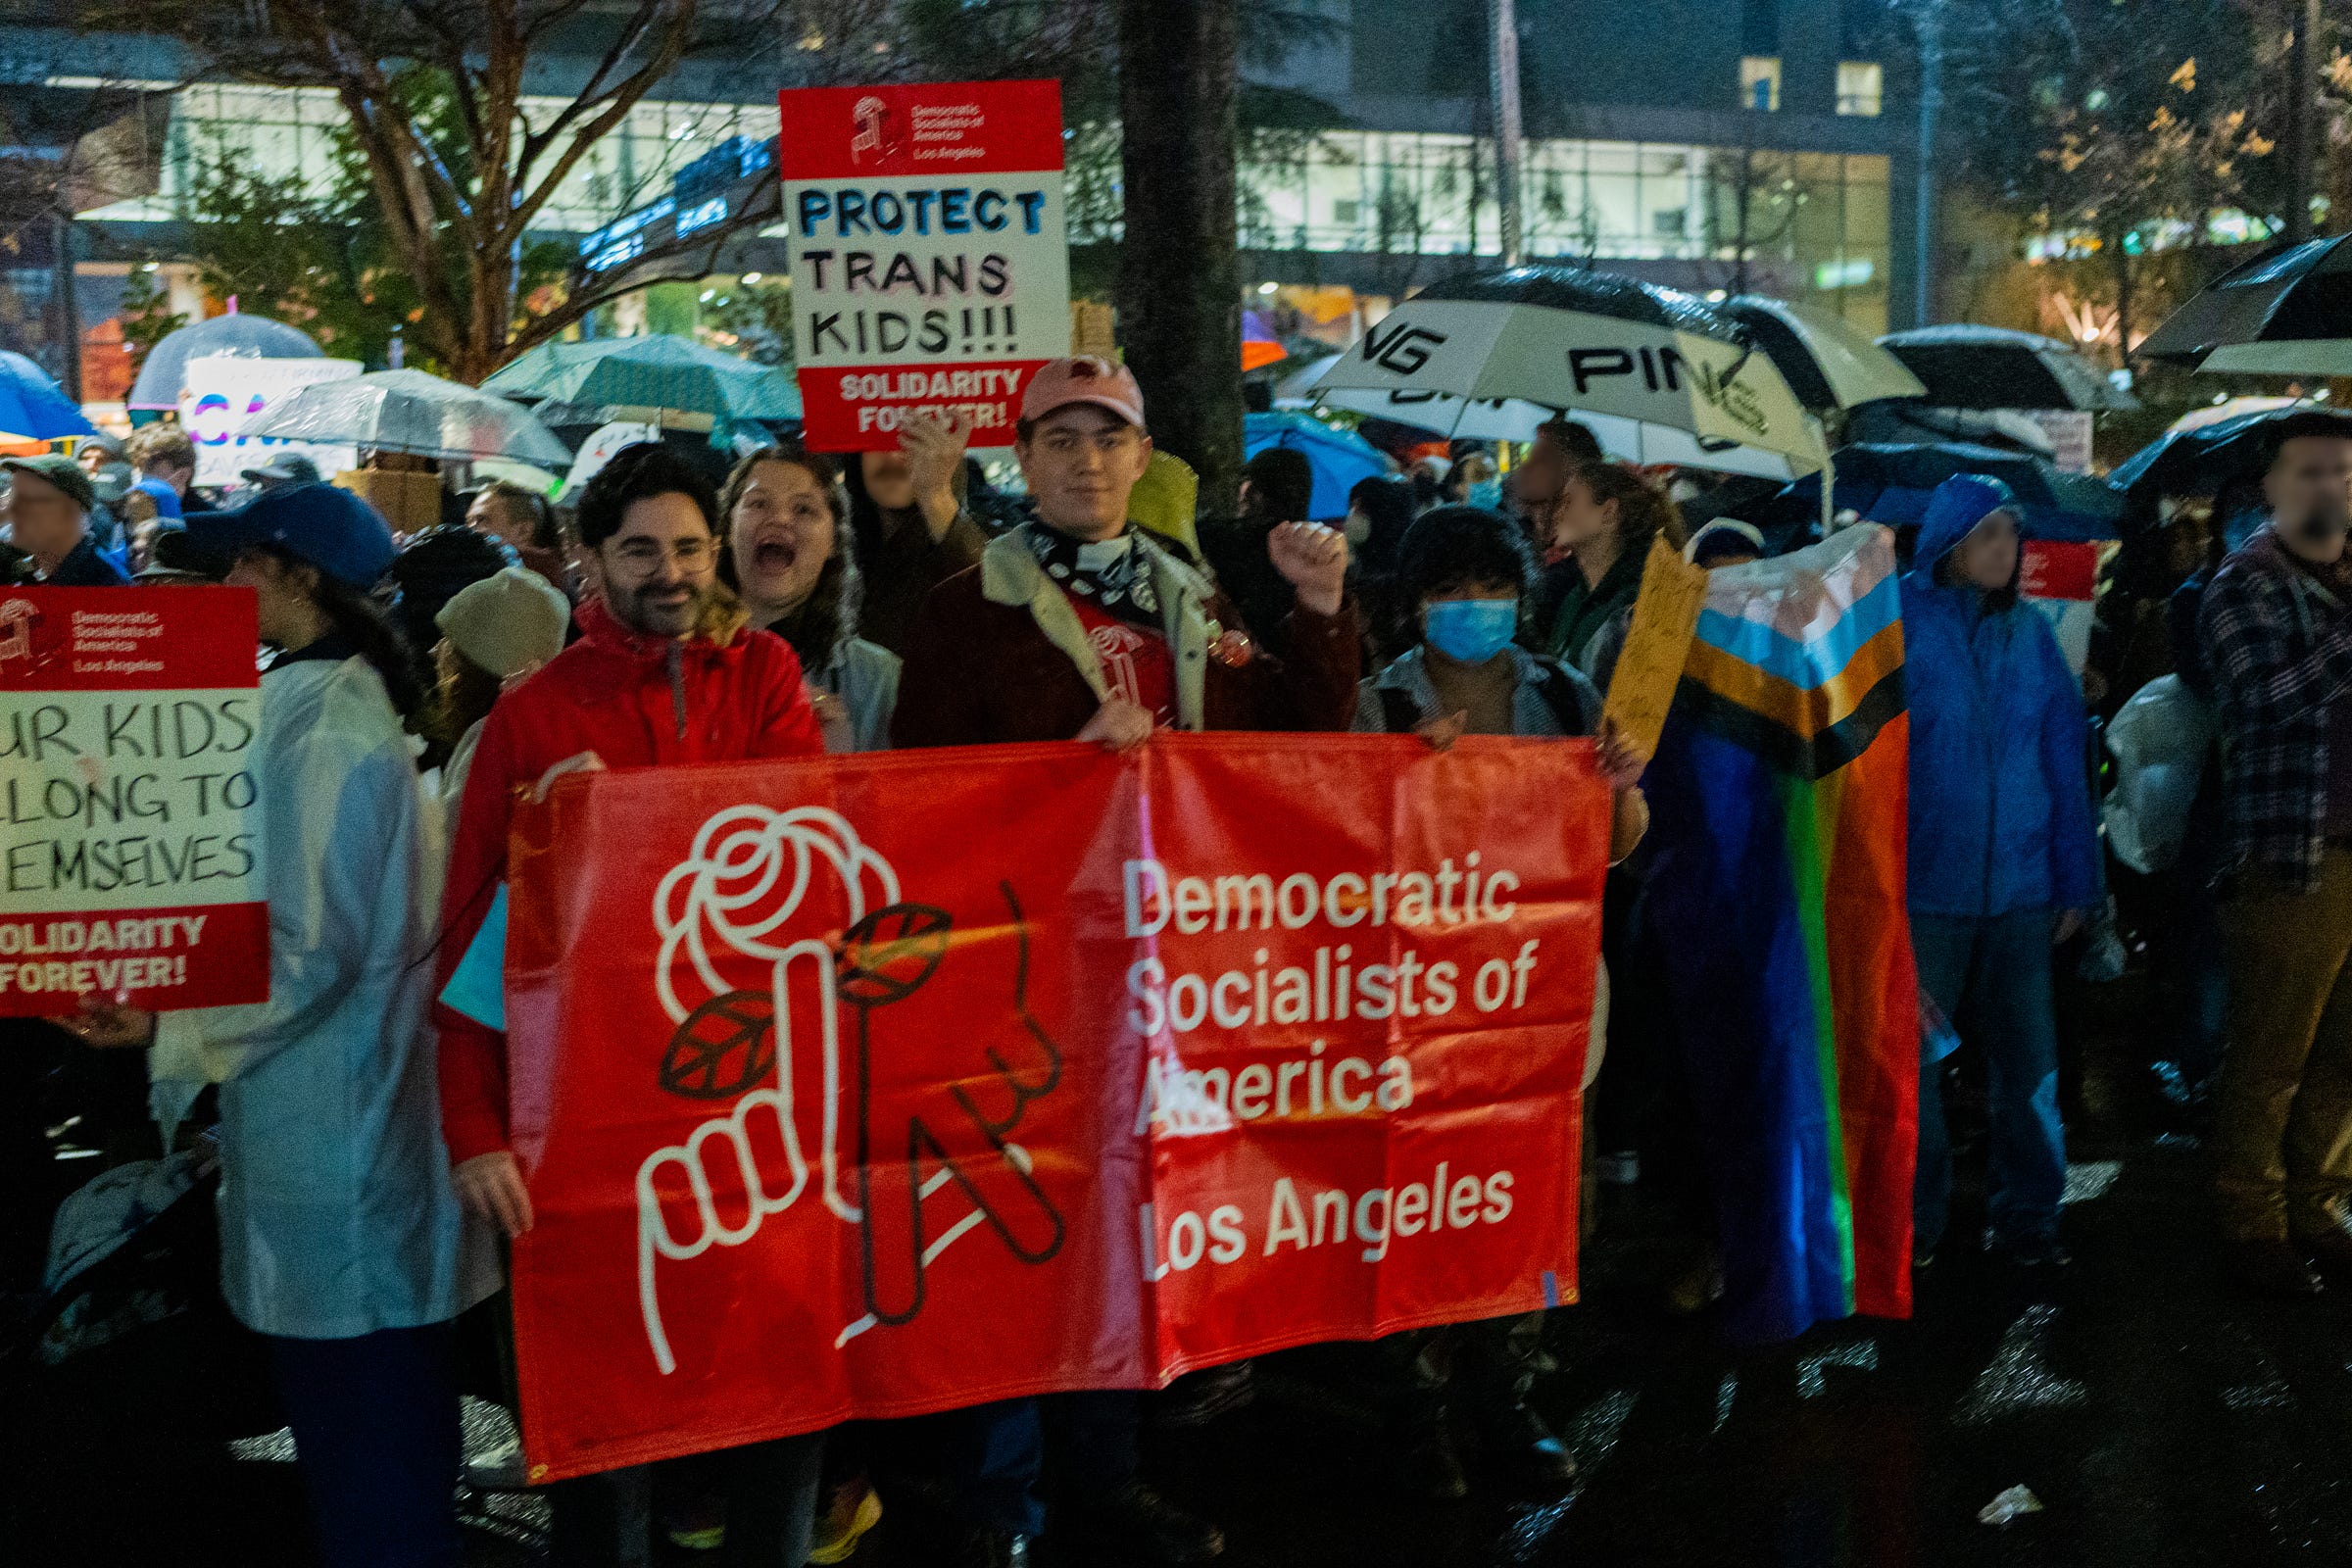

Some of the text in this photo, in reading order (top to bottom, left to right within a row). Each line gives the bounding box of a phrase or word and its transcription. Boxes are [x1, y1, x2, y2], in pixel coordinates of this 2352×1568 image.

[913, 148, 935, 160] Los
[799, 187, 1046, 237] PROTECT
[802, 249, 1014, 297] TRANS
[809, 302, 1018, 356] KIDS!!!
[840, 368, 1023, 401] SOLIDARITY
[73, 658, 102, 672] Los
[103, 699, 254, 760] KIDS
[0, 770, 257, 828] LONG TO
[7, 833, 258, 892] EMSELVES
[1122, 849, 1520, 939] Democratic
[0, 914, 209, 956] OLIDARITY
[0, 955, 187, 995] FOREVER!
[1126, 937, 1541, 1038] Socialists of
[1133, 1038, 1415, 1137] America
[1138, 1160, 1515, 1283] Los Angeles
